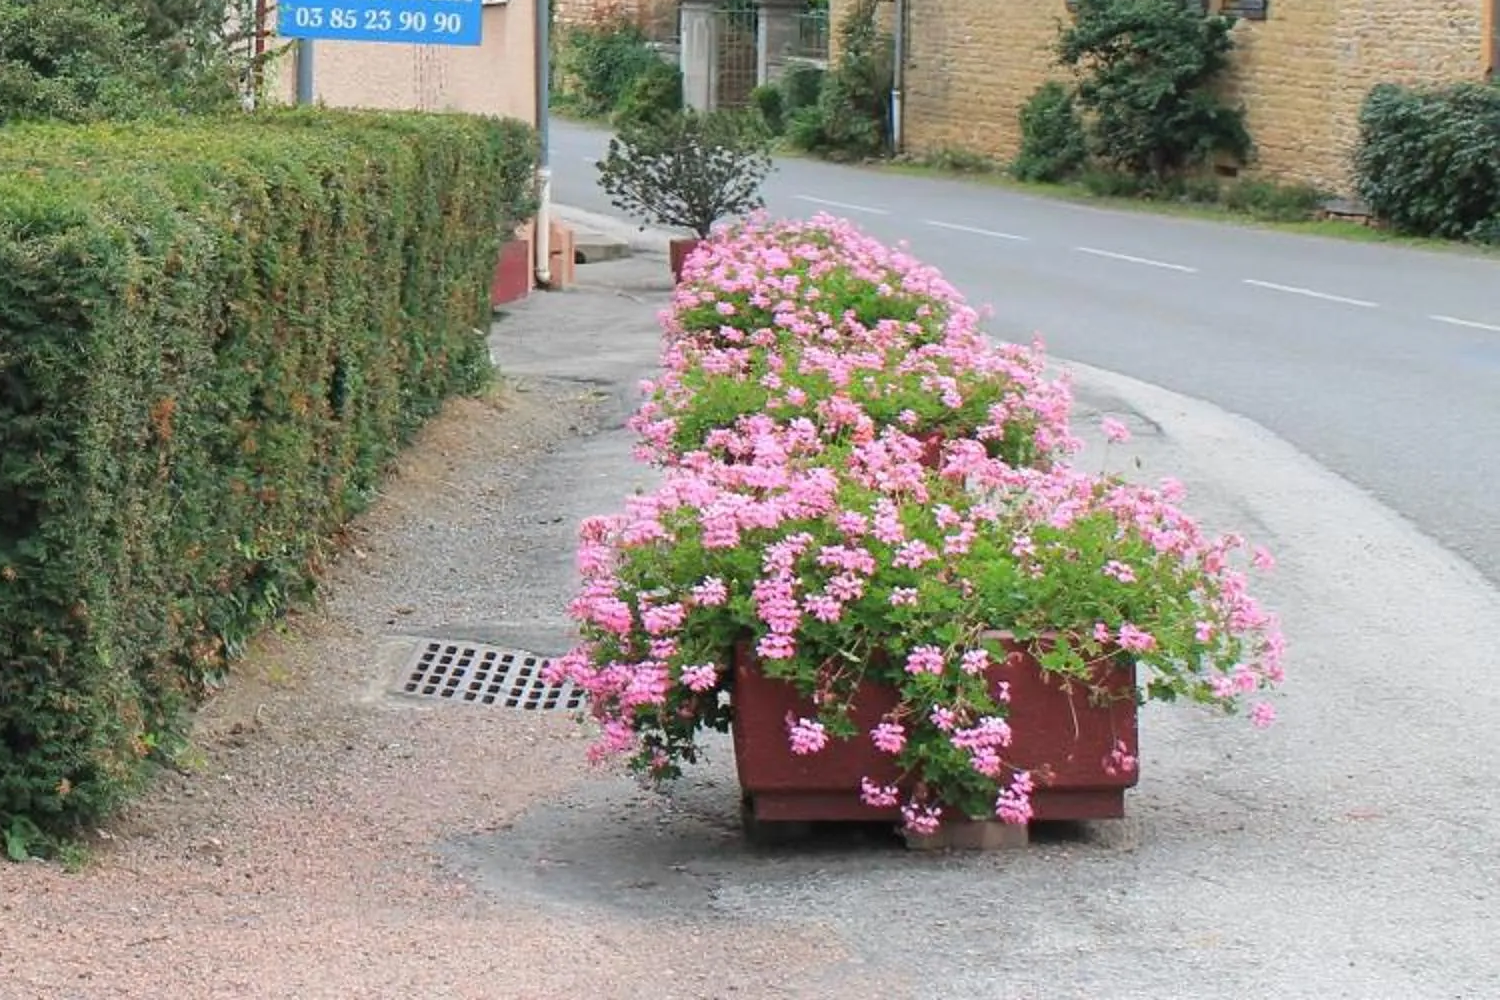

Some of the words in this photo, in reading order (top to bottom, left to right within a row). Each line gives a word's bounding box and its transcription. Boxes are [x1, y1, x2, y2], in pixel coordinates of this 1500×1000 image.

[296, 6, 323, 28] 03
[330, 8, 357, 29] 85
[364, 9, 392, 31] 23
[399, 11, 426, 33] 90
[433, 12, 461, 34] 90
